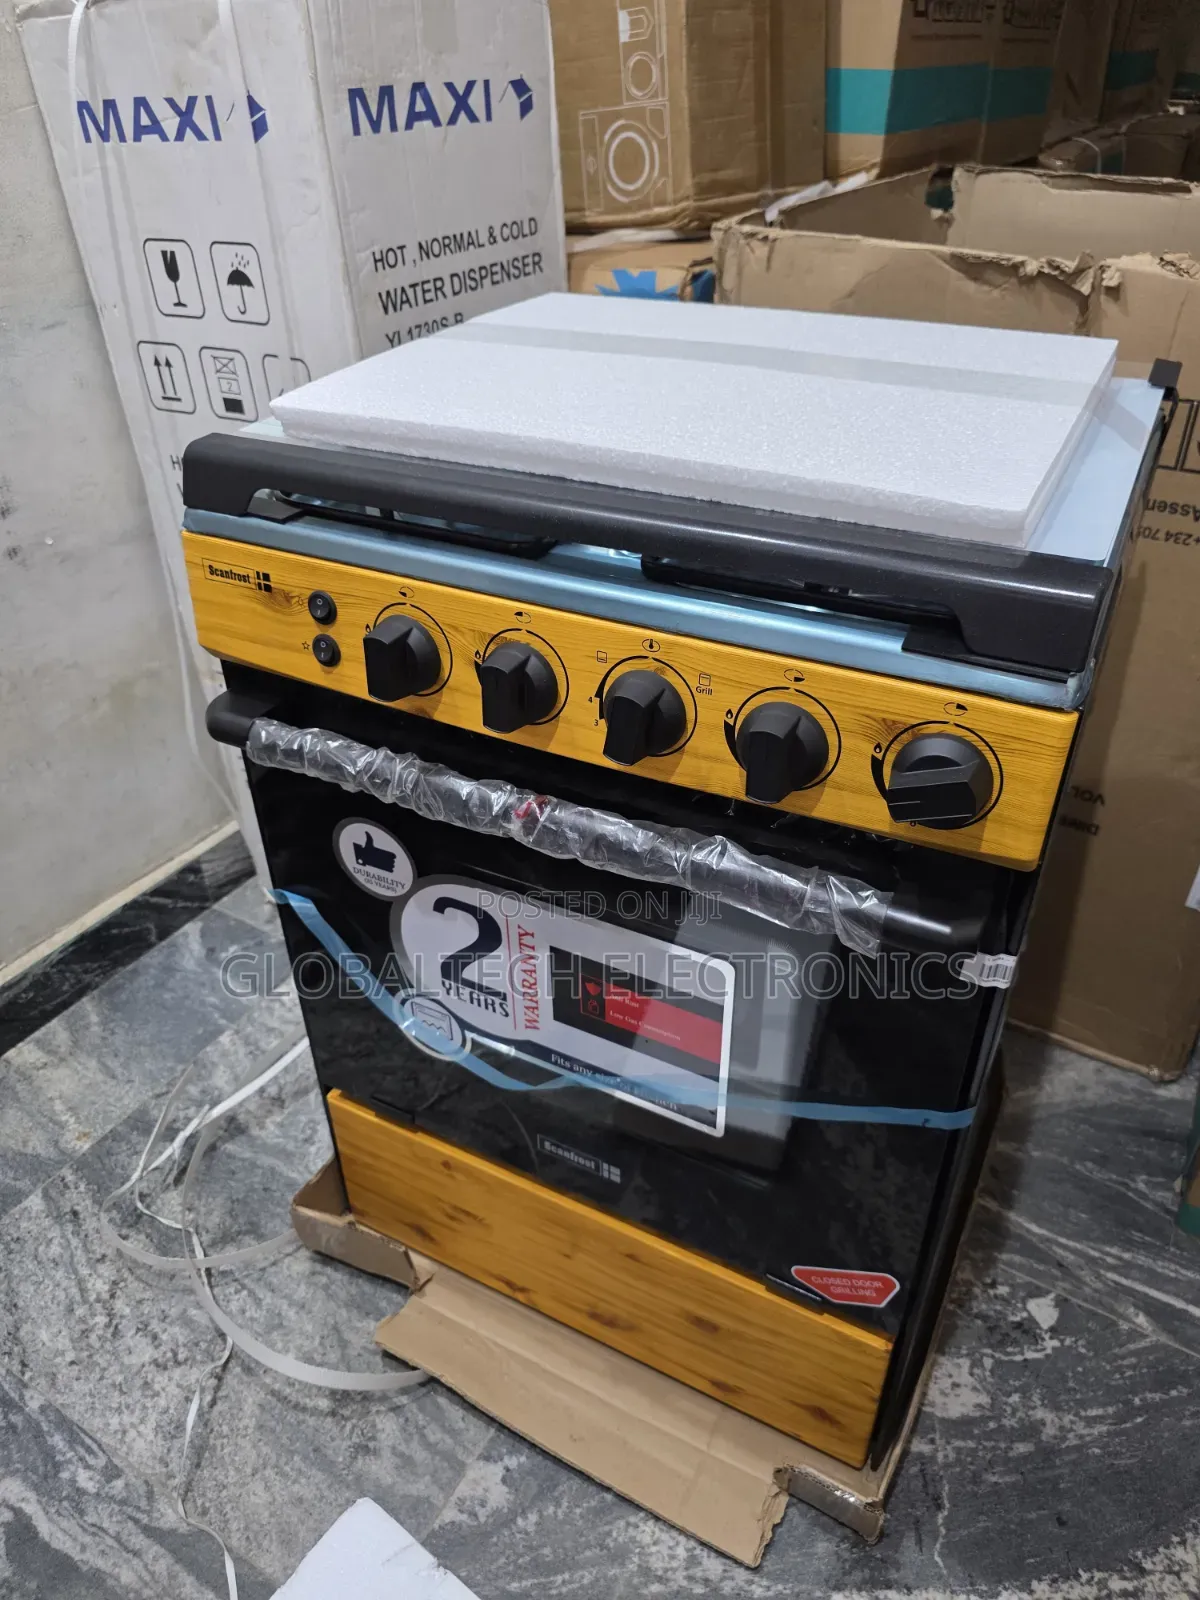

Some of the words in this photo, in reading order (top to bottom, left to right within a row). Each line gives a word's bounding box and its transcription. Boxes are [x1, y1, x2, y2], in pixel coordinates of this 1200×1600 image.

[77, 94, 222, 144] MAXI
[348, 79, 493, 136] MAXI
[418, 229, 485, 262] NORMAL
[488, 225, 498, 246] &
[500, 216, 538, 243] COLD
[378, 276, 447, 316] WATER
[450, 251, 544, 297] DISPENSER
[208, 564, 252, 585] Scanfrost
[695, 685, 713, 696] Grill
[352, 866, 406, 890] DURABILITY
[433, 896, 507, 1002] 2
[518, 924, 541, 1031] WARRANTY
[441, 979, 510, 1018] YEARS
[625, 998, 639, 1009] Rust
[610, 1010, 623, 1020] Low
[625, 1014, 638, 1025] Gas
[551, 1053, 571, 1069] Fits
[573, 1064, 593, 1077] any
[811, 1275, 851, 1287] CLOSED
[852, 1278, 884, 1289] DOOR
[830, 1285, 877, 1297] GRILLING
